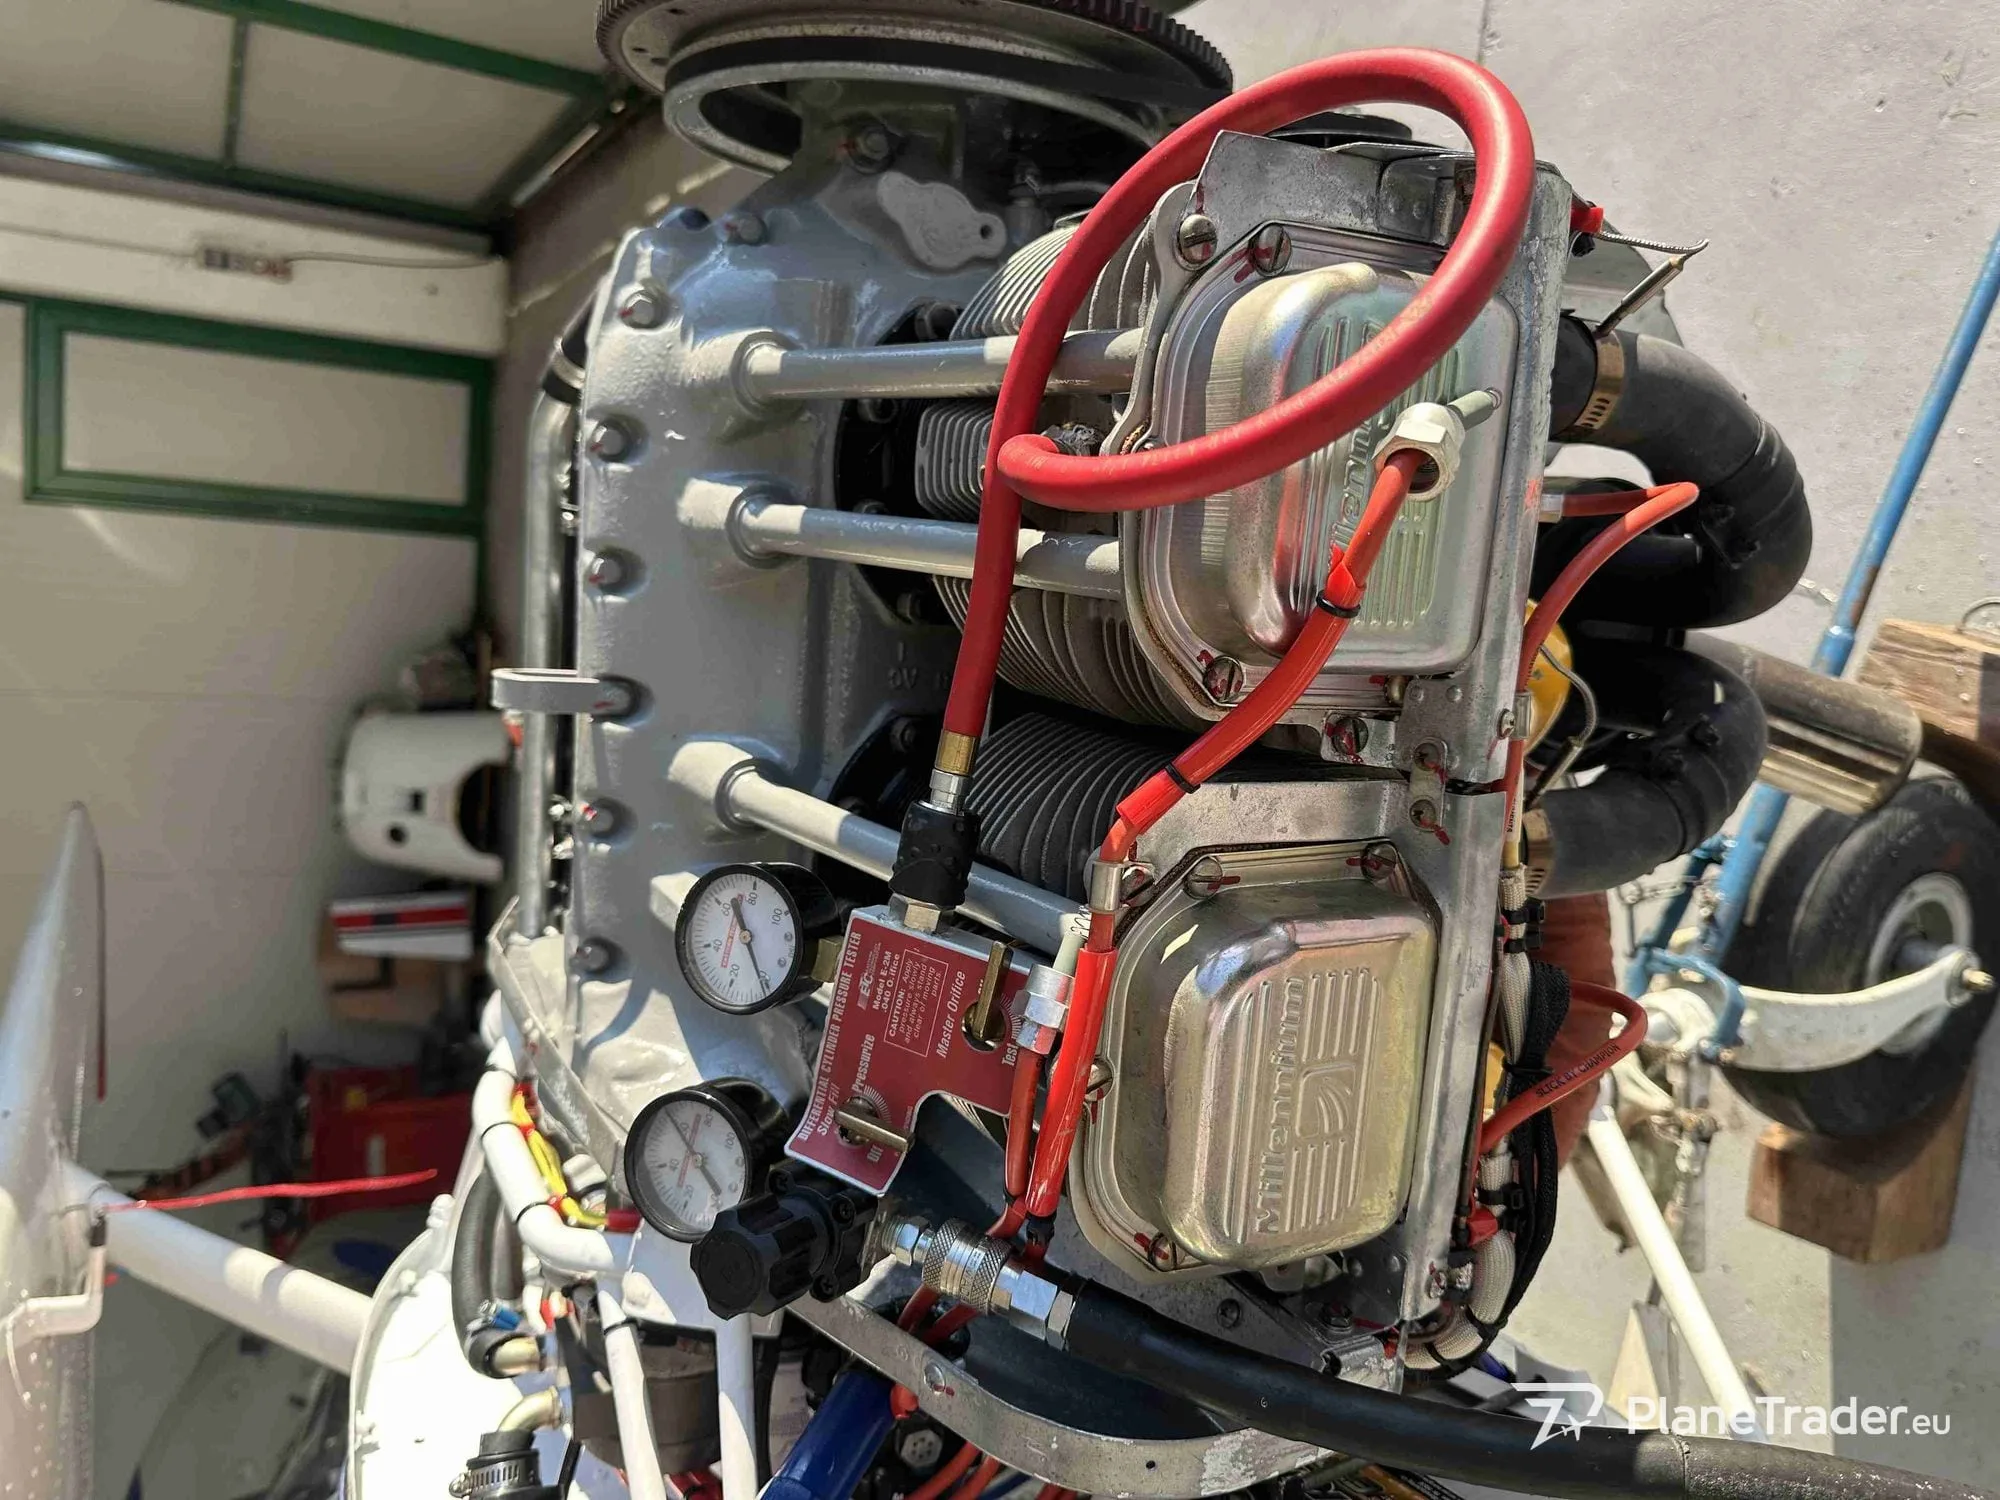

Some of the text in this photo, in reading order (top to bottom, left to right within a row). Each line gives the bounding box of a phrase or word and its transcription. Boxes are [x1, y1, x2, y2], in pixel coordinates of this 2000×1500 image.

[720, 902, 731, 917] 60
[747, 891, 758, 905] 80
[771, 907, 783, 926] 100
[712, 938, 723, 952] 40
[729, 963, 740, 978] 20
[872, 979, 886, 1010] Model
[880, 951, 892, 976] E-2M
[881, 990, 892, 1013] .040
[889, 958, 914, 1037] CAUTION: Apply
[899, 961, 921, 1034] pressure slowly
[904, 963, 928, 1044] and always stand
[913, 1015, 924, 1038] clear
[922, 966, 936, 1000] moving
[797, 931, 862, 1141] DIFFERENTIAL CYLINDER PRESSURE TESTER
[936, 970, 966, 1059] Master Orifice
[851, 1033, 876, 1093] Pressurize
[1001, 1043, 1018, 1066] Test
[1535, 1078, 1565, 1098] SLICK
[1579, 1042, 1622, 1073] CHAMPION
[817, 1082, 841, 1136] Slow Fill
[1256, 976, 1304, 1234] Millennium
